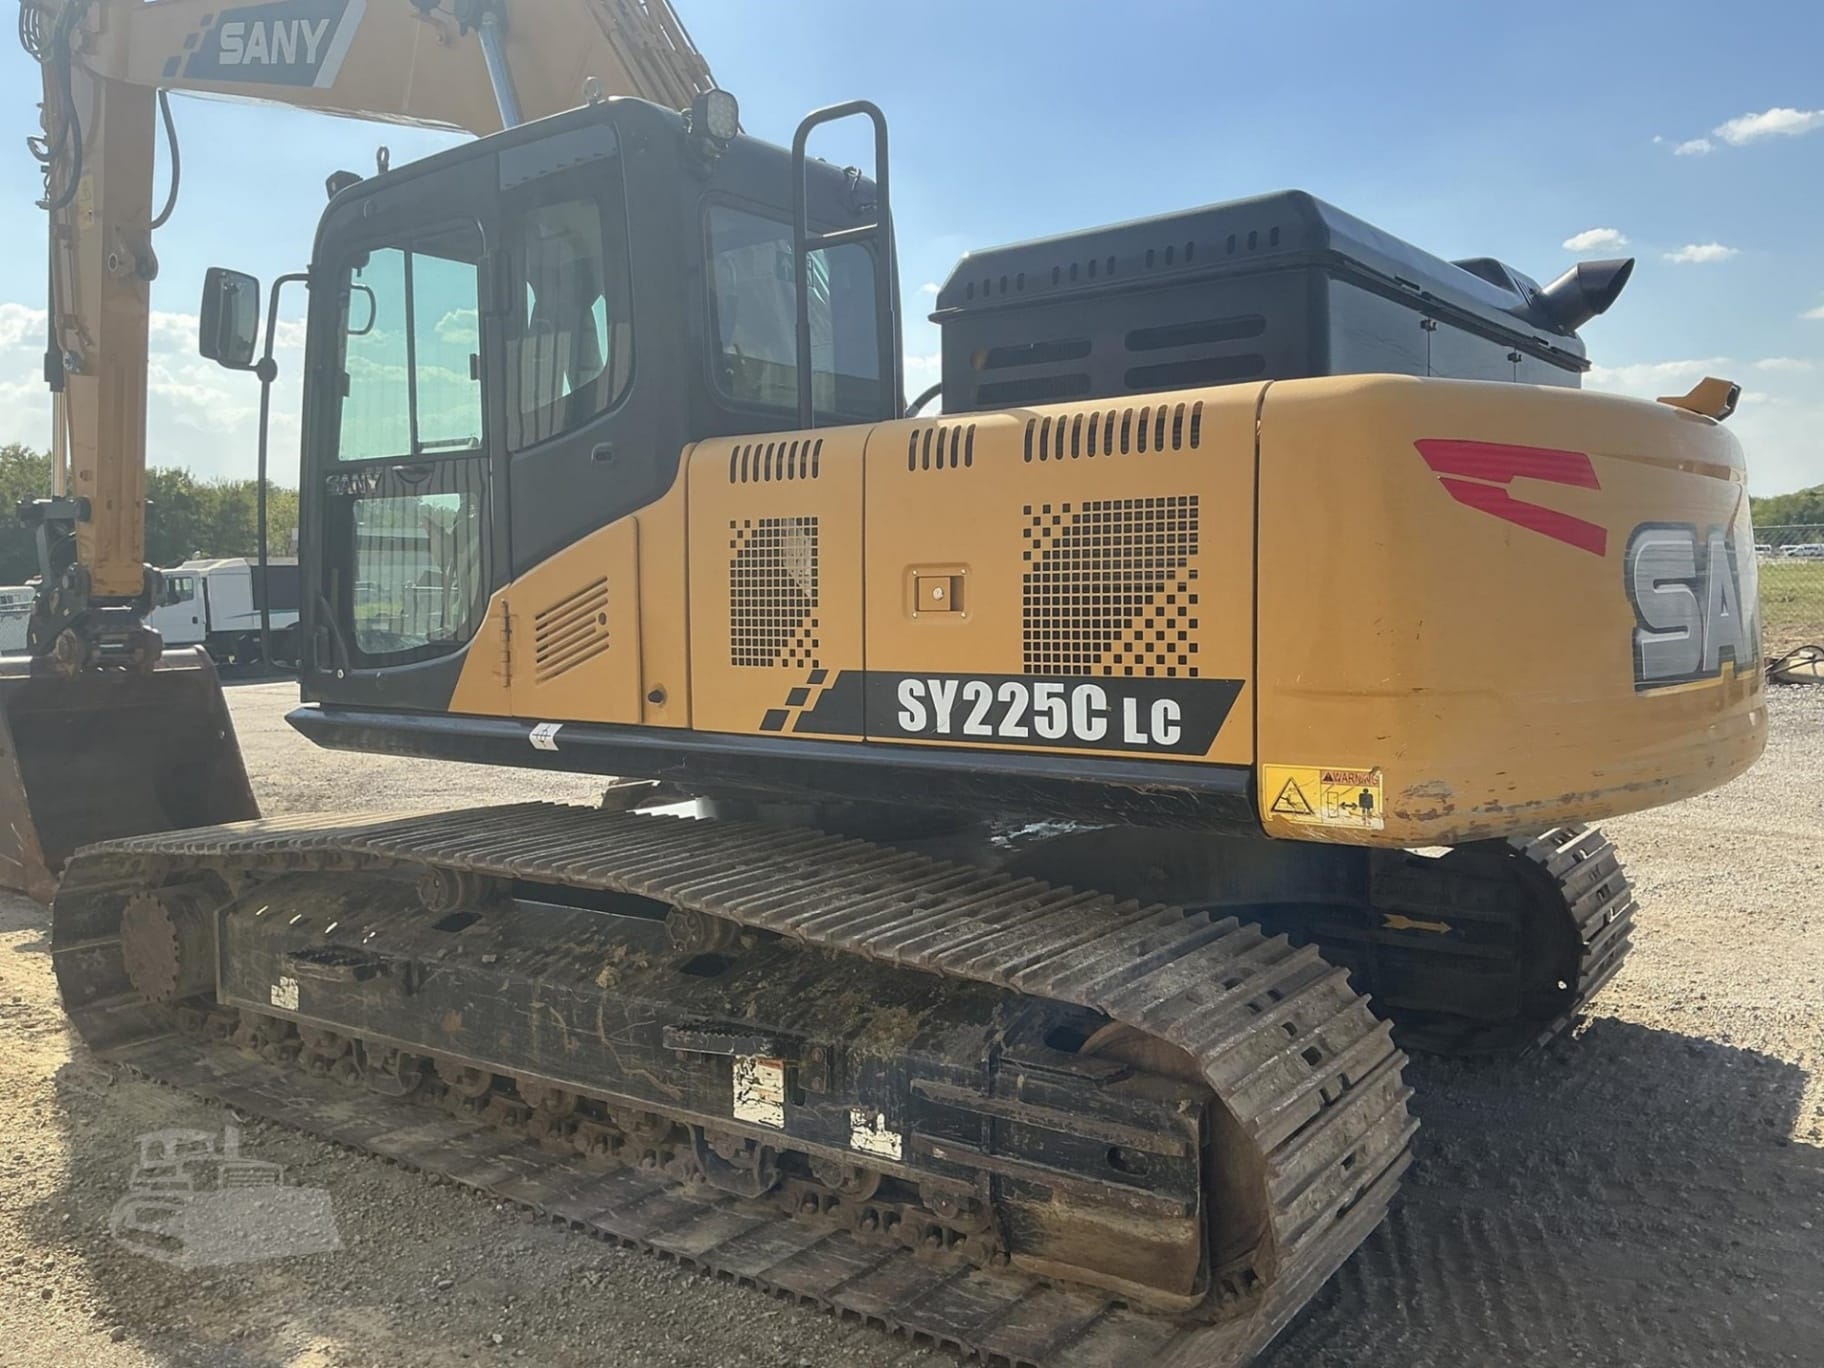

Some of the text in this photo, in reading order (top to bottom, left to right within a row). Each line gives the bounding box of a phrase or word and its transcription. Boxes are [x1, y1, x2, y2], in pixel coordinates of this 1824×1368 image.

[218, 18, 331, 65] SANY
[325, 470, 383, 496] SANY
[1625, 524, 1759, 684] SA
[897, 678, 1182, 746] SY225C LC
[1332, 771, 1379, 786] WARNING
